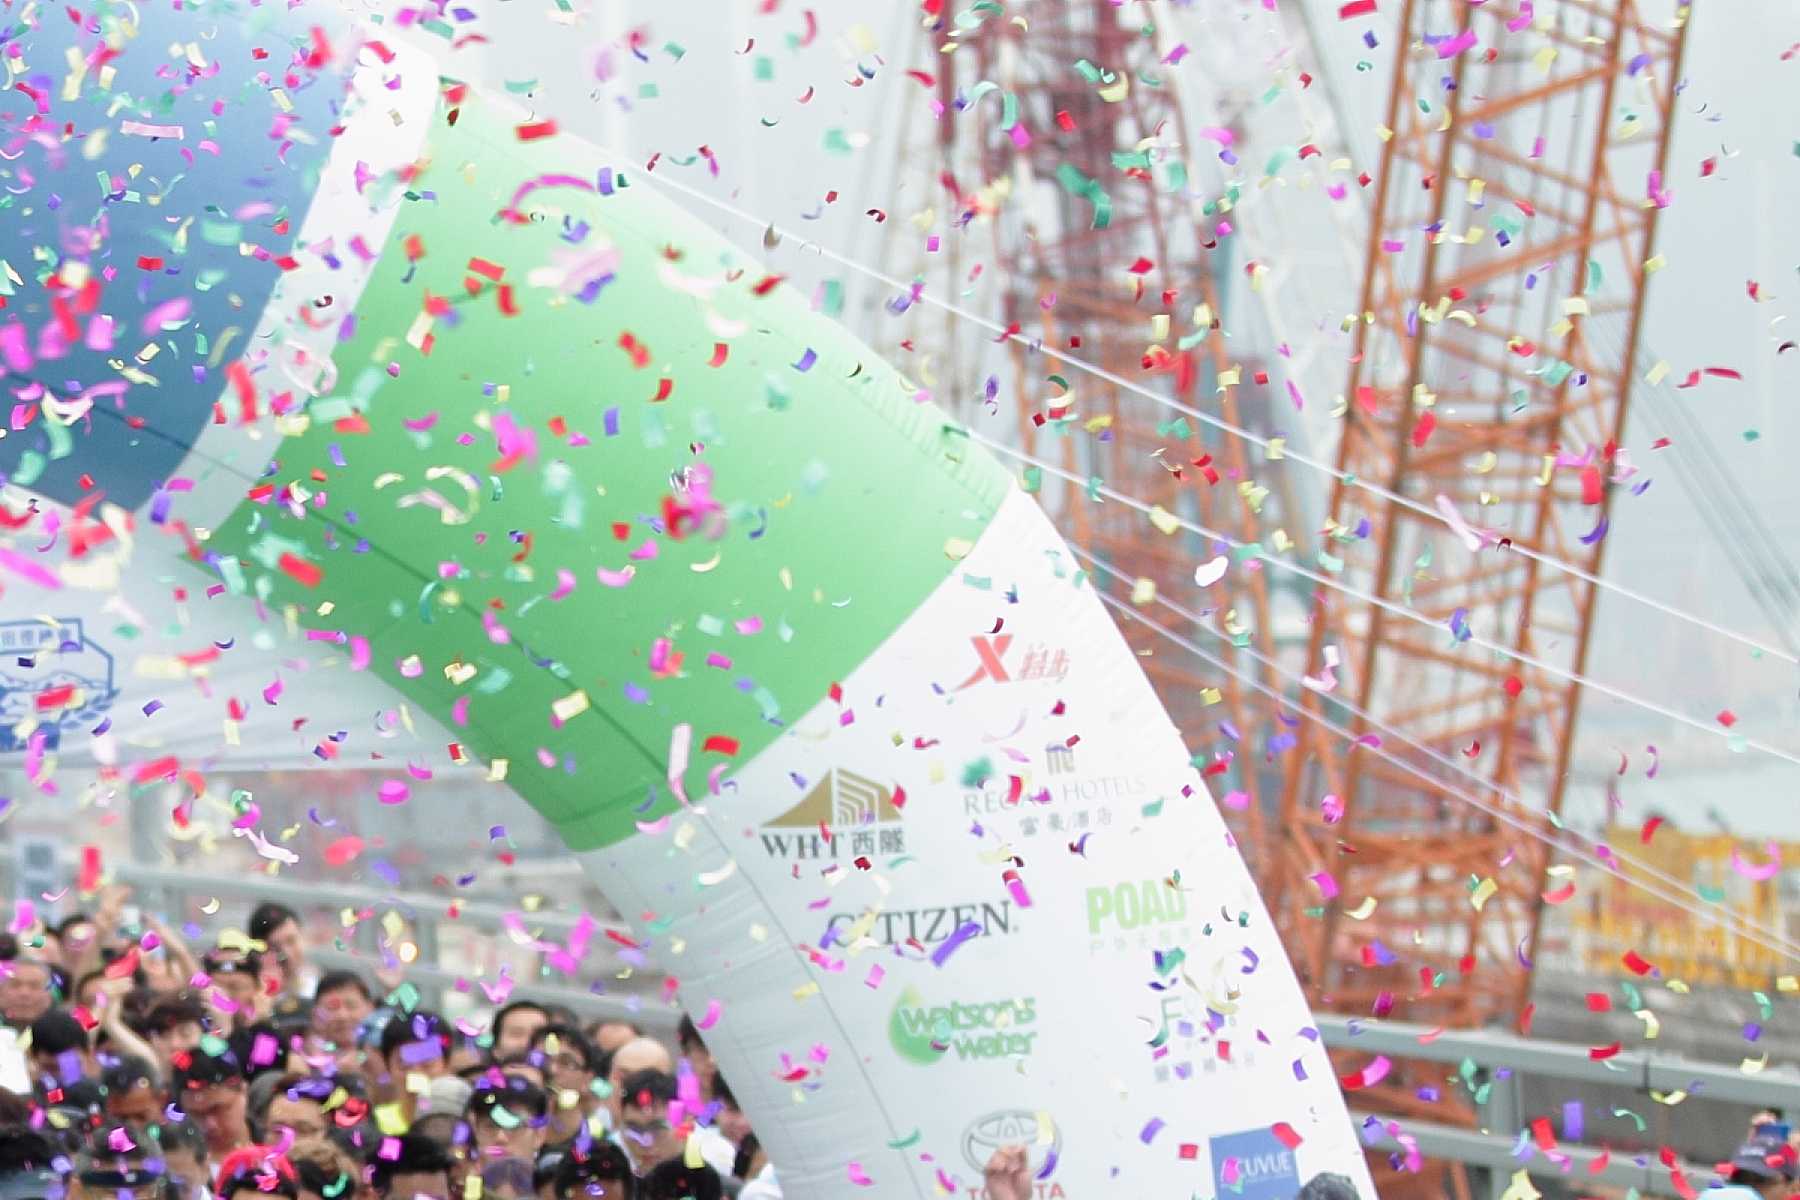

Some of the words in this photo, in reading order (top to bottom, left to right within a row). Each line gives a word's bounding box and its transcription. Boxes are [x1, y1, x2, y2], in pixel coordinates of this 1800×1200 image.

[1062, 774, 1147, 803] HOTELS
[761, 832, 845, 860] WHT
[1085, 878, 1188, 936] POAD
[952, 1030, 1039, 1062] water
